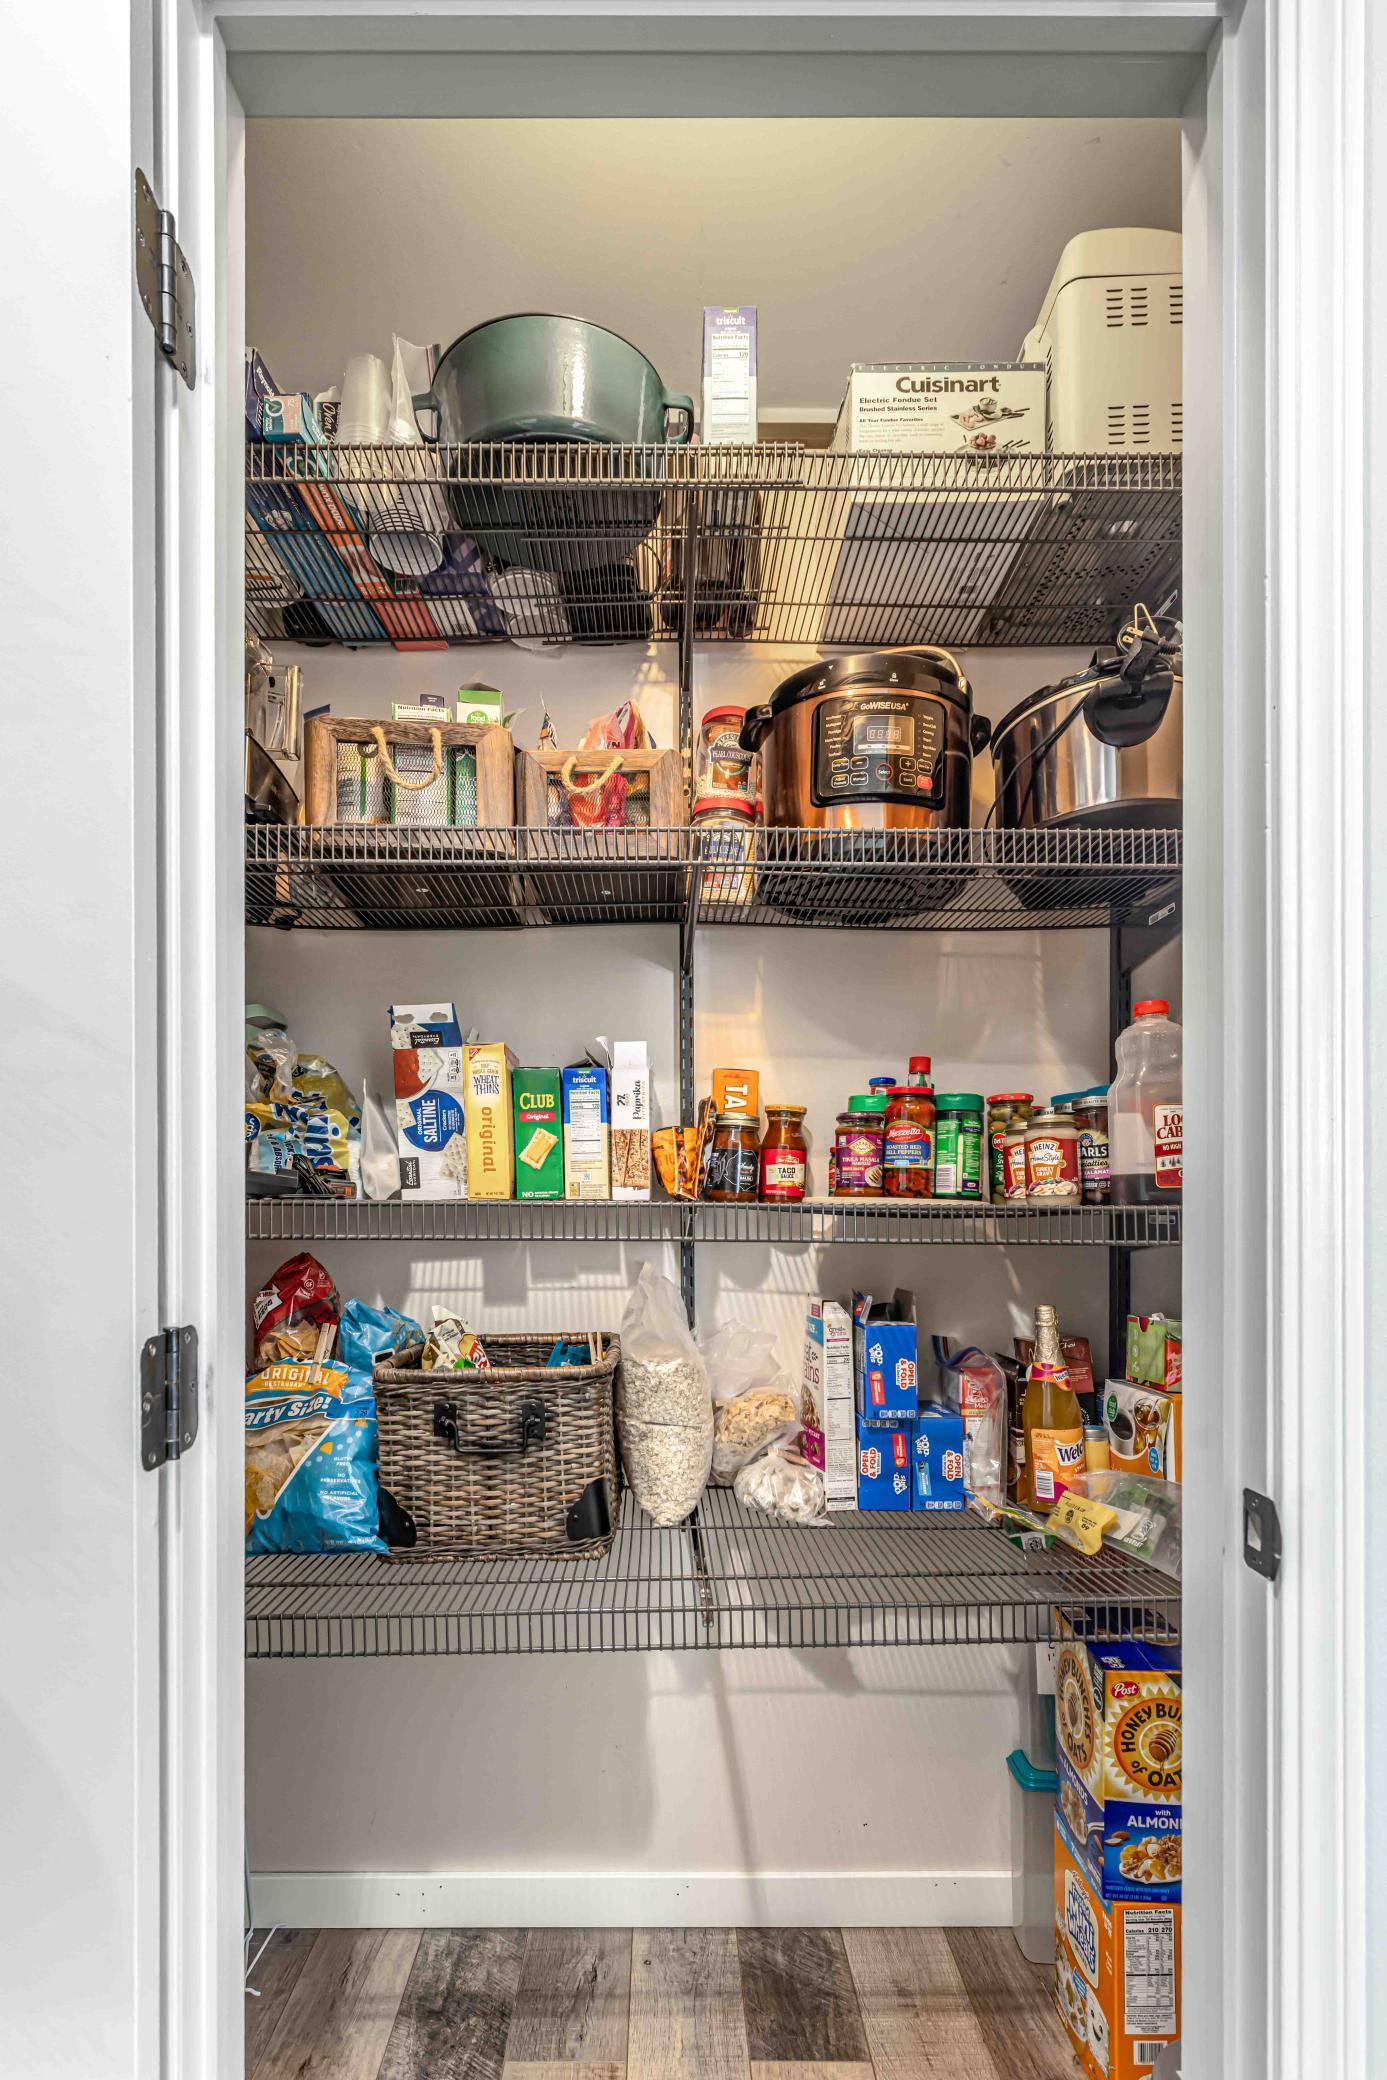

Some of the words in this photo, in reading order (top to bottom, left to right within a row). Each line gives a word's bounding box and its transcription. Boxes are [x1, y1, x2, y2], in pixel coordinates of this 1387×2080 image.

[716, 315, 746, 326] triscuit
[896, 376, 1000, 394] Cuisinart
[472, 1075, 500, 1084] WHEAT
[572, 1076, 597, 1084] triscuit
[474, 1084, 500, 1095] THINS
[520, 1092, 554, 1110] CLUB
[633, 1080, 641, 1120] Paprika
[422, 1099, 438, 1142] SALTINE
[526, 1113, 549, 1121] Original
[480, 1106, 496, 1173] original
[888, 1128, 921, 1138] Mezzetta
[1032, 1153, 1060, 1162] HomeStyle
[288, 1396, 332, 1417] Size!
[1114, 1683, 1137, 1696] Post
[1121, 1706, 1152, 1753] HONEY
[1068, 1734, 1088, 1763] OATS
[1132, 1761, 1148, 1774] of
[1064, 1760, 1088, 1806] ALMONDS
[1067, 1906, 1096, 1974] Wheats
